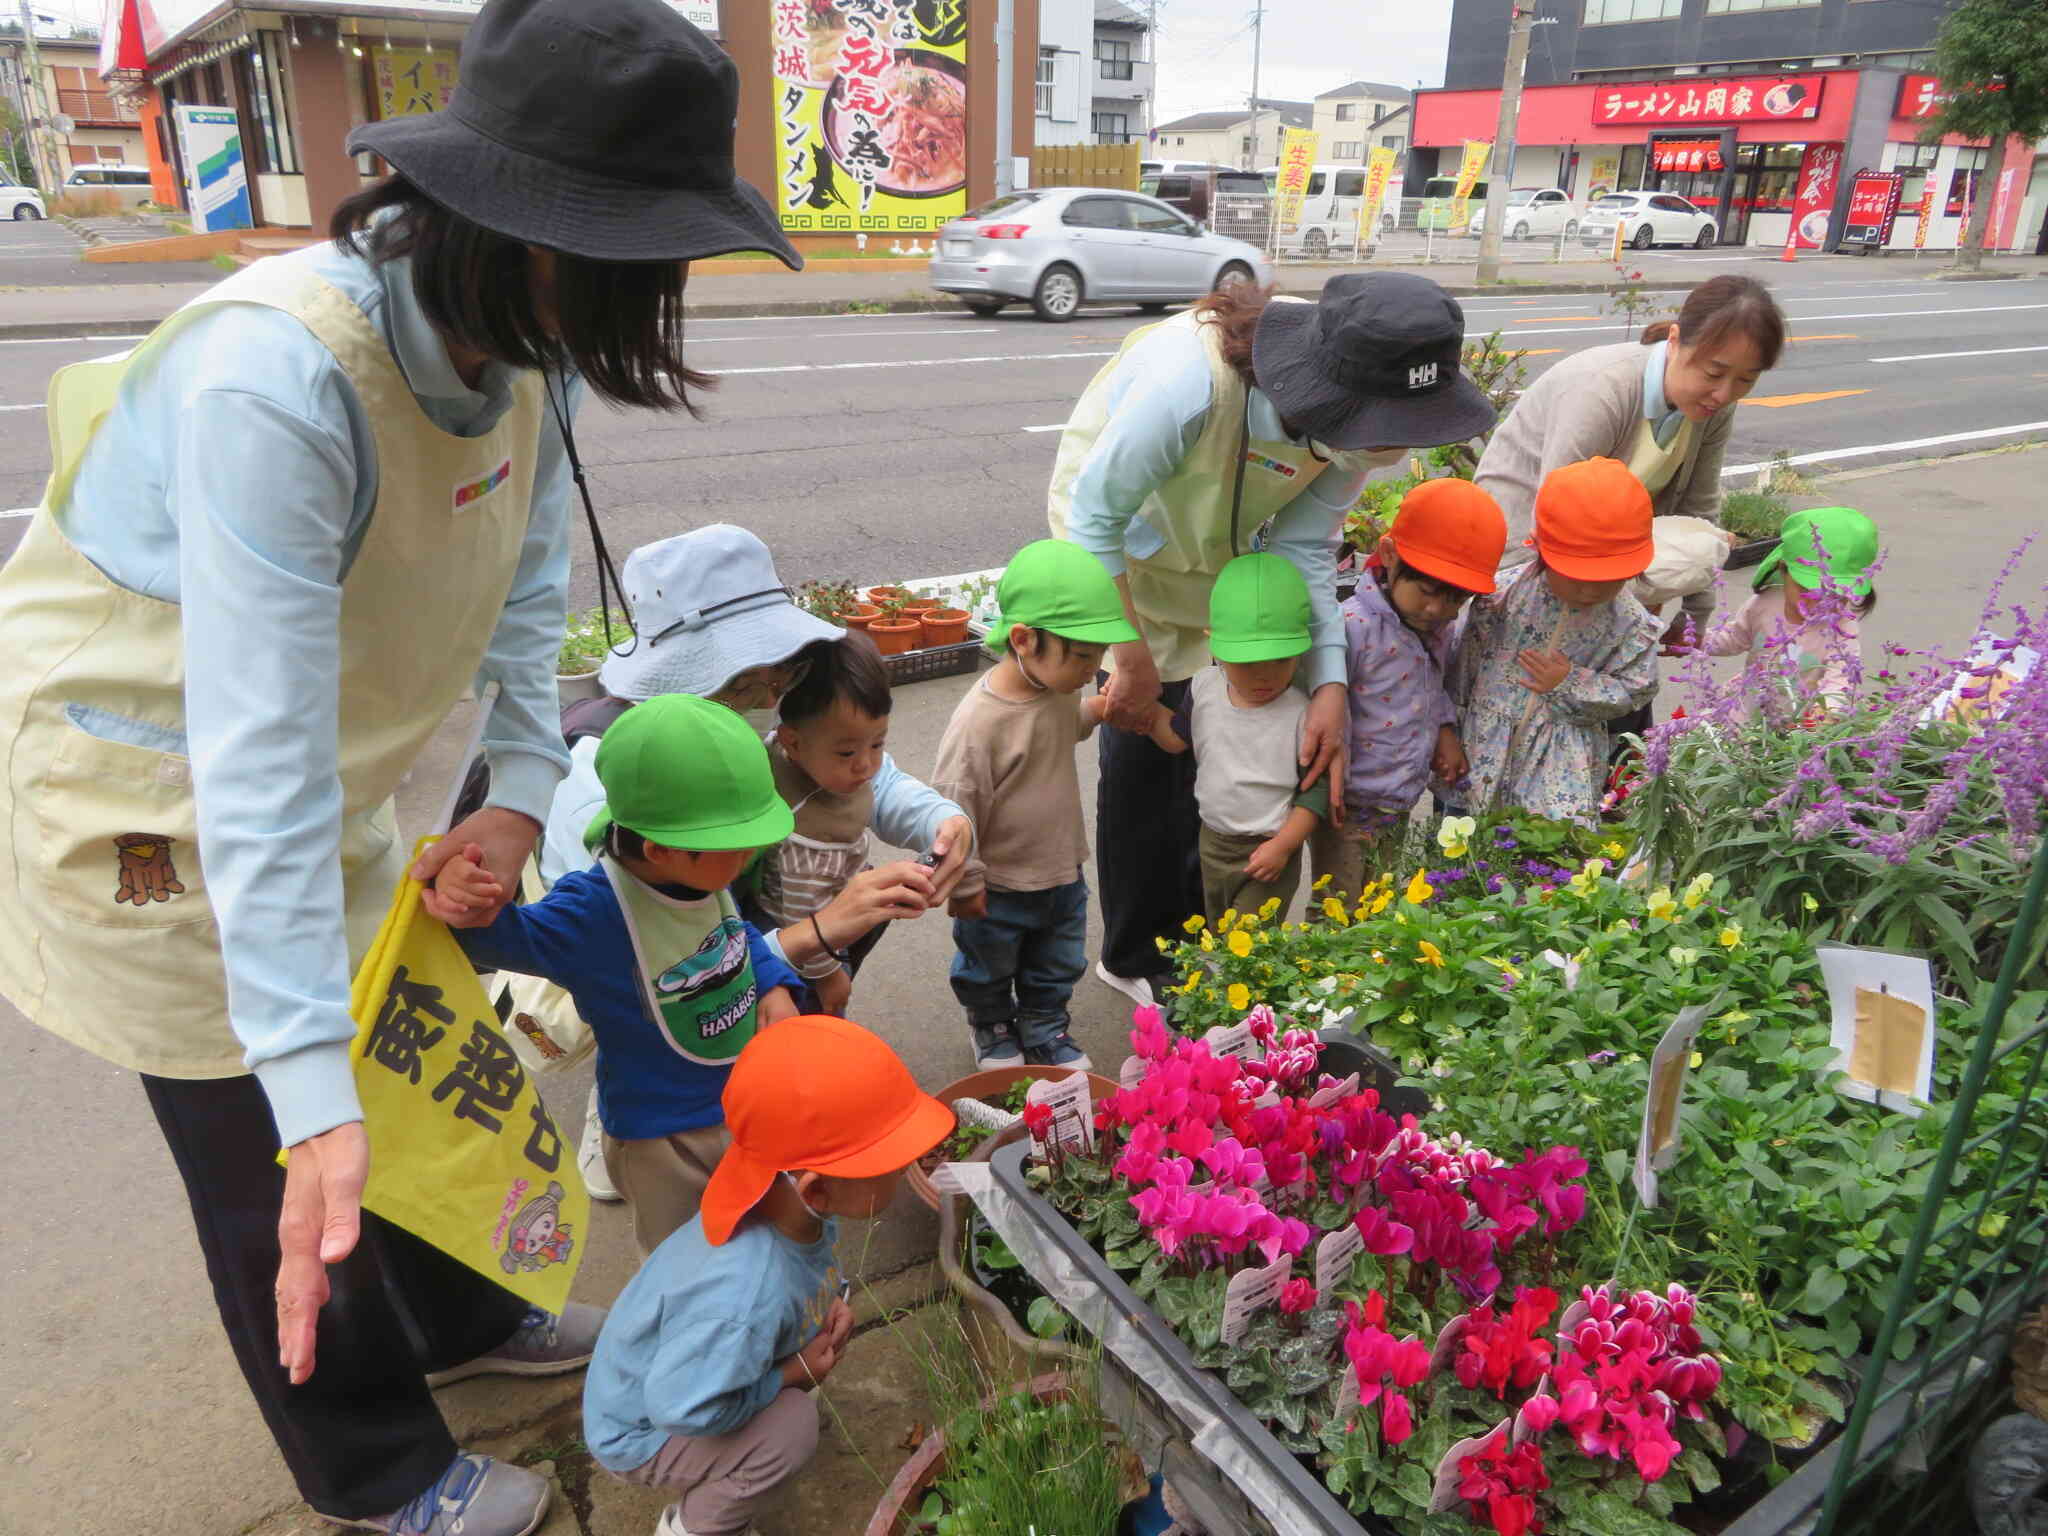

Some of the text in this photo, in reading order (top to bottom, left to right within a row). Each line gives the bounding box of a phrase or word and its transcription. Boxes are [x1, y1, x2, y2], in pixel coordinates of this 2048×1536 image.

[776, 2, 811, 206] 茨城タンメン
[1605, 85, 1754, 119] ラーメン山岡家
[1864, 226, 1878, 241] P
[1409, 362, 1438, 385] HH
